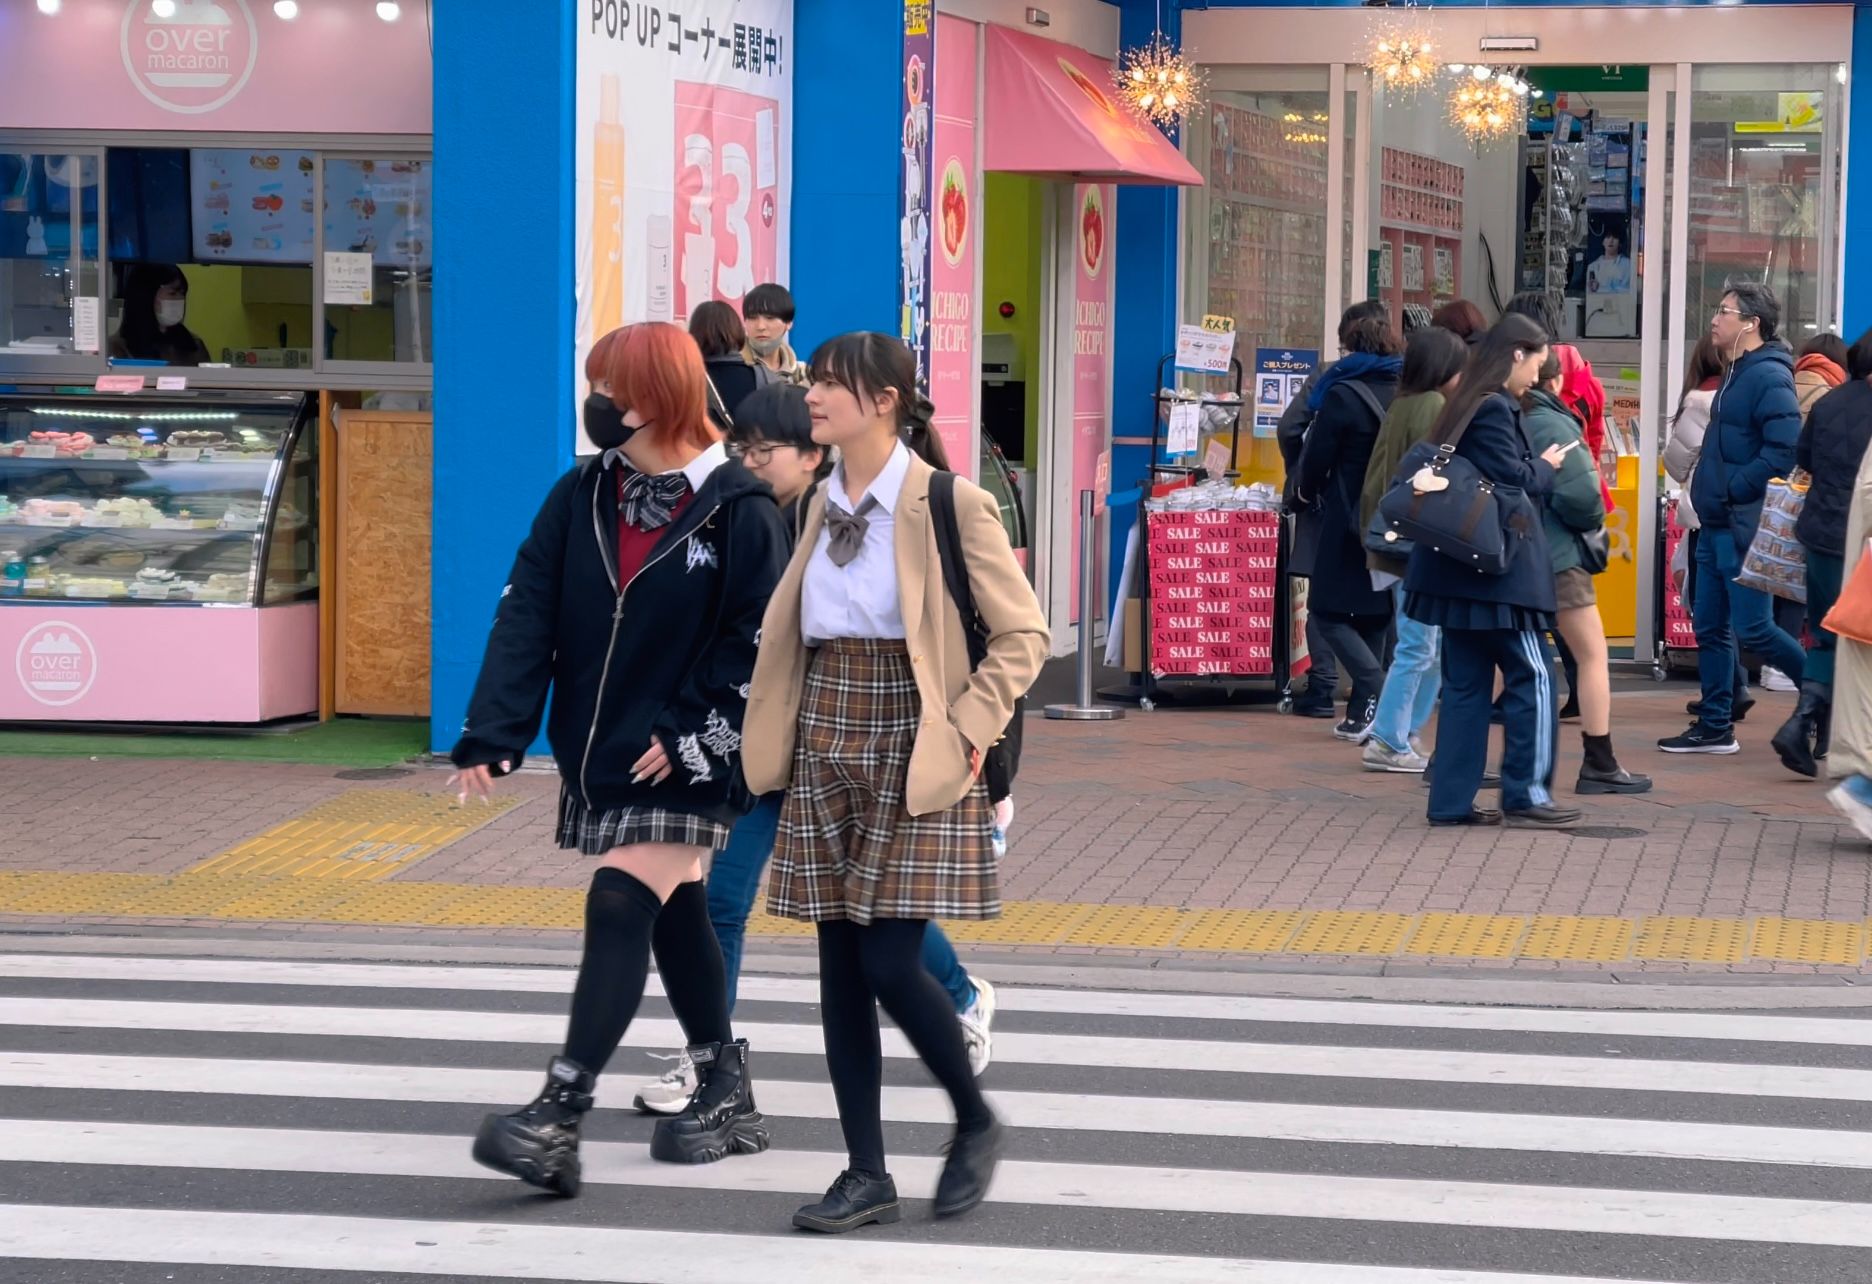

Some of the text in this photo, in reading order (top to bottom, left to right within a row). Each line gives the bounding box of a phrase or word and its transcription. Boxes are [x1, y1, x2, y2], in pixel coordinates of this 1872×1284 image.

[145, 28, 231, 52] over
[592, 0, 783, 77] POP UP コーナー展開中!
[148, 54, 229, 69] macaron
[932, 290, 969, 321] ICHIGO
[1077, 299, 1105, 327] ICHIGO
[1204, 318, 1232, 333] 大人気
[931, 323, 968, 353] RECIPE
[1074, 329, 1104, 355] RECIPE
[1154, 513, 1187, 524] SALE
[1195, 513, 1229, 524] SALE
[1236, 513, 1269, 523] SALE
[1167, 528, 1201, 539] SALE
[1208, 528, 1241, 538] SALE
[1156, 542, 1269, 554] SALE SALE SALE
[1168, 558, 1202, 569] SALE
[1208, 558, 1241, 568] SALE
[1156, 572, 1270, 583] SALE SALE SALE
[1168, 588, 1202, 599] SALE
[1209, 588, 1241, 598] SALE
[1249, 587, 1274, 598] SAL
[1157, 602, 1268, 613] SALE SALE SALE
[1169, 617, 1203, 628] SALE
[1210, 618, 1242, 628] SALE
[1249, 617, 1272, 628] SAL
[1158, 632, 1269, 643] SALE SALE SALE
[1170, 647, 1204, 658] SALE
[1211, 647, 1242, 658] SALE
[31, 655, 81, 670] over
[1158, 661, 1268, 673] SALE SALE SALE
